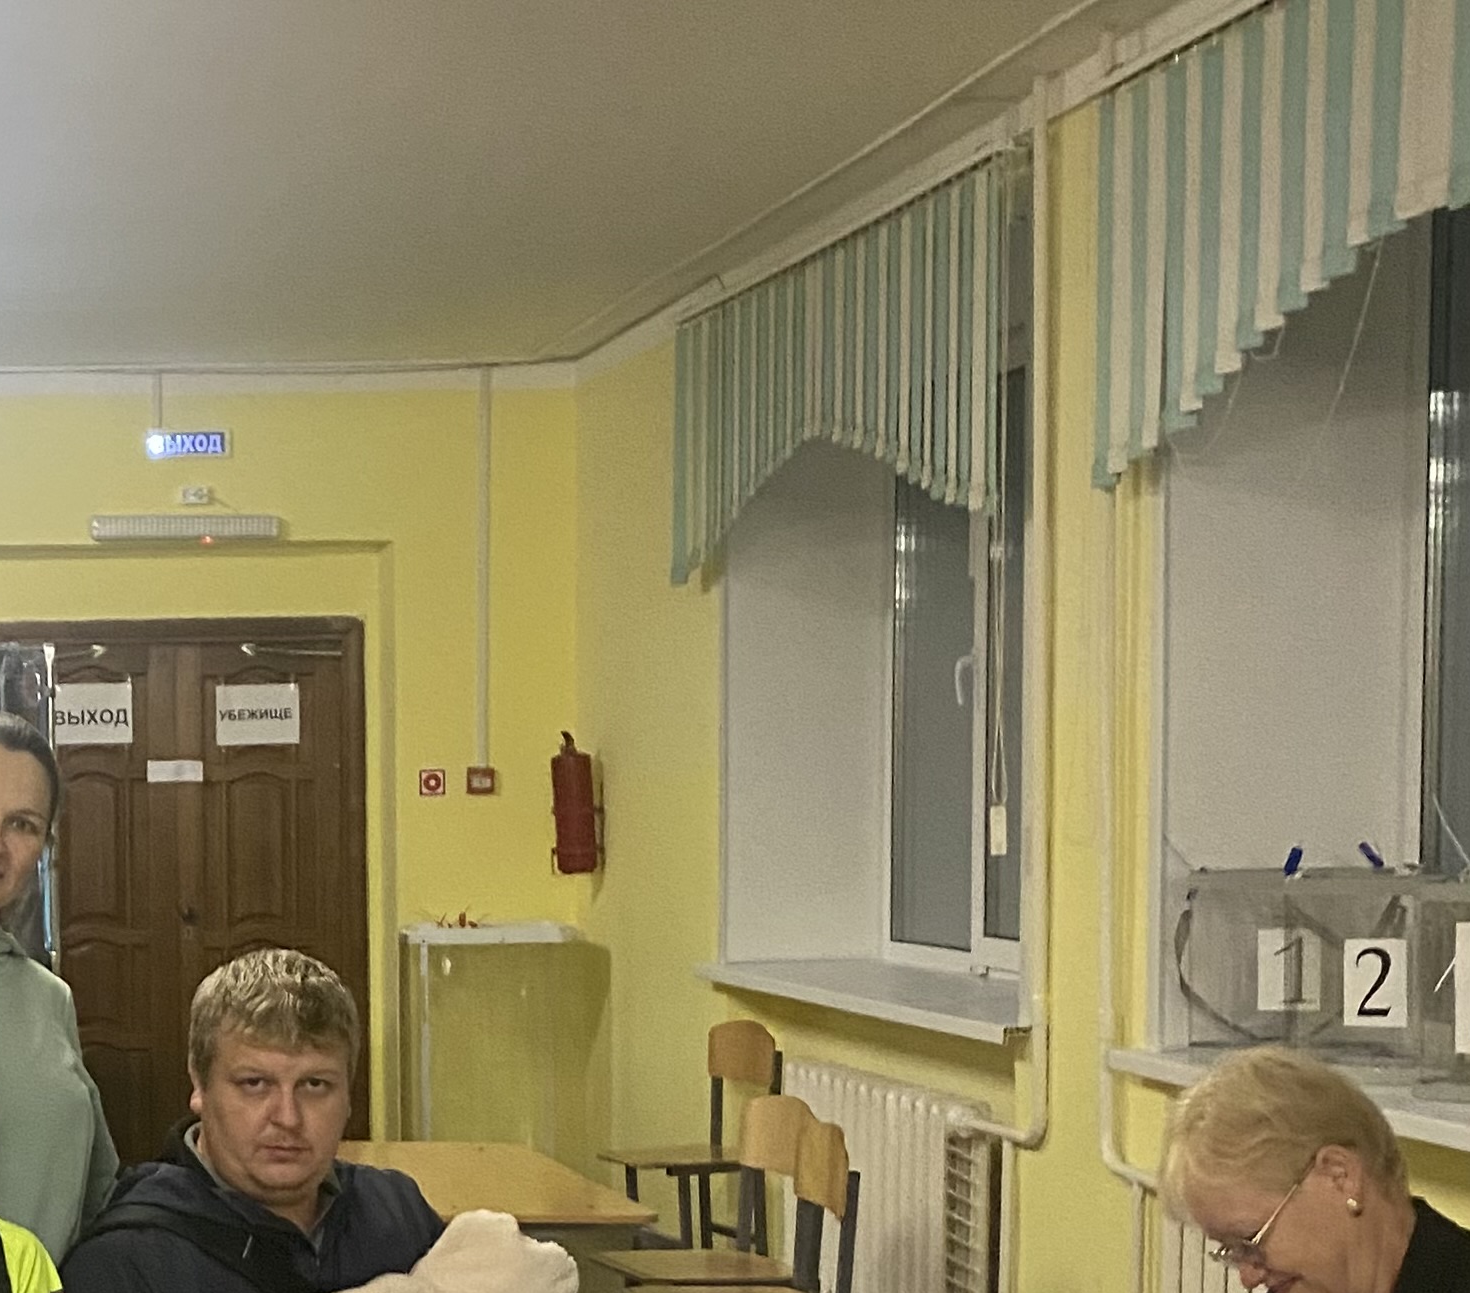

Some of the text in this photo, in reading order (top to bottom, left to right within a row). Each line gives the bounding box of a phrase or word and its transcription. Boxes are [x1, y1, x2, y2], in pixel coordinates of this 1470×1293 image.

[54, 708, 130, 728] ВЫХОД
[218, 706, 293, 722] УБЕЖИЩЕ
[1273, 936, 1310, 1004] 1
[1355, 946, 1393, 1018] 2
